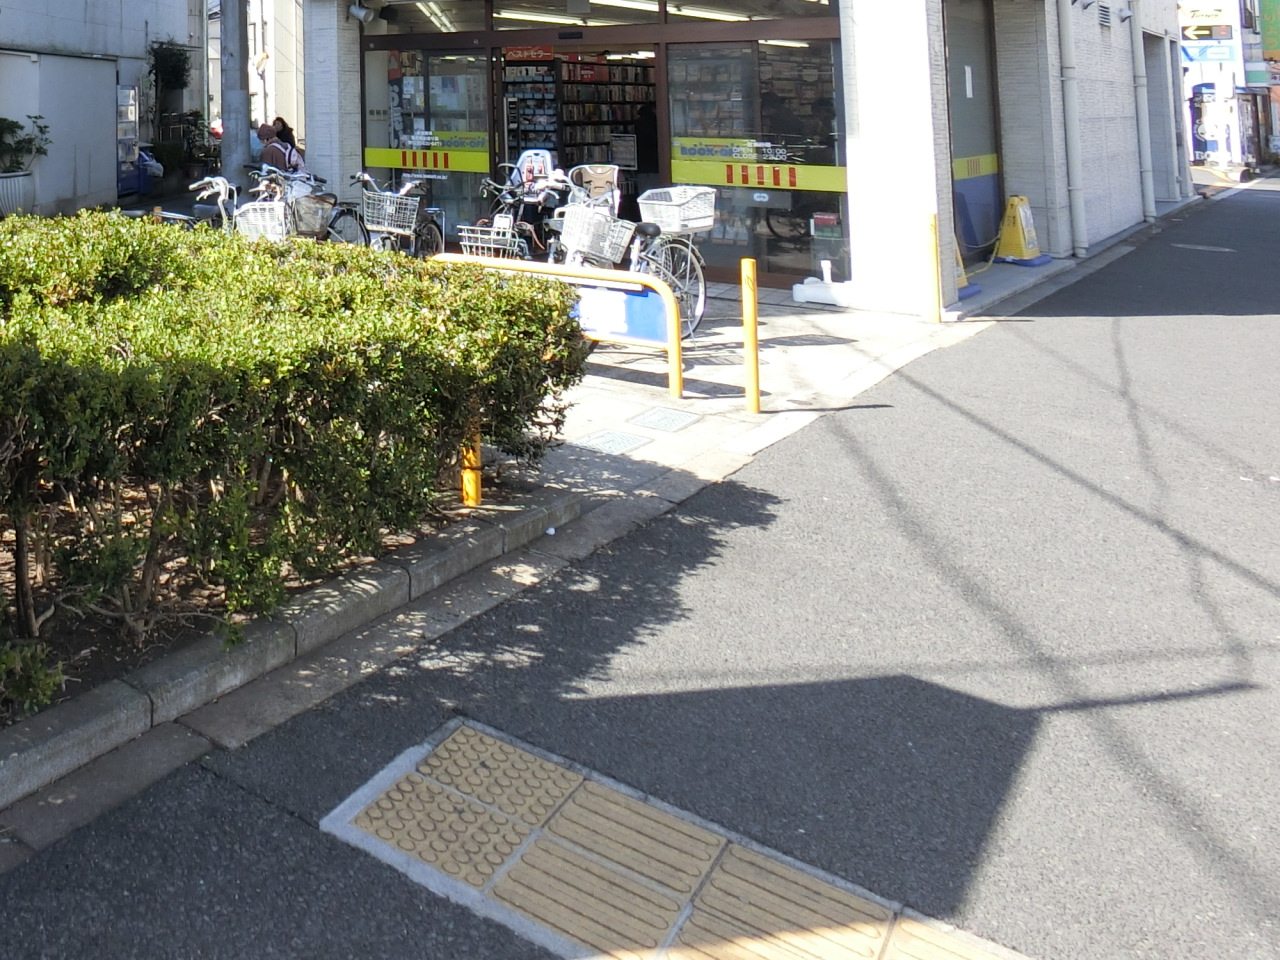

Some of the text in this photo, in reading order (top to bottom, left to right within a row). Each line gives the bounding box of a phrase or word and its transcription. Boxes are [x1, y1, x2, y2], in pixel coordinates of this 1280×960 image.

[506, 50, 552, 59] ベストセラー
